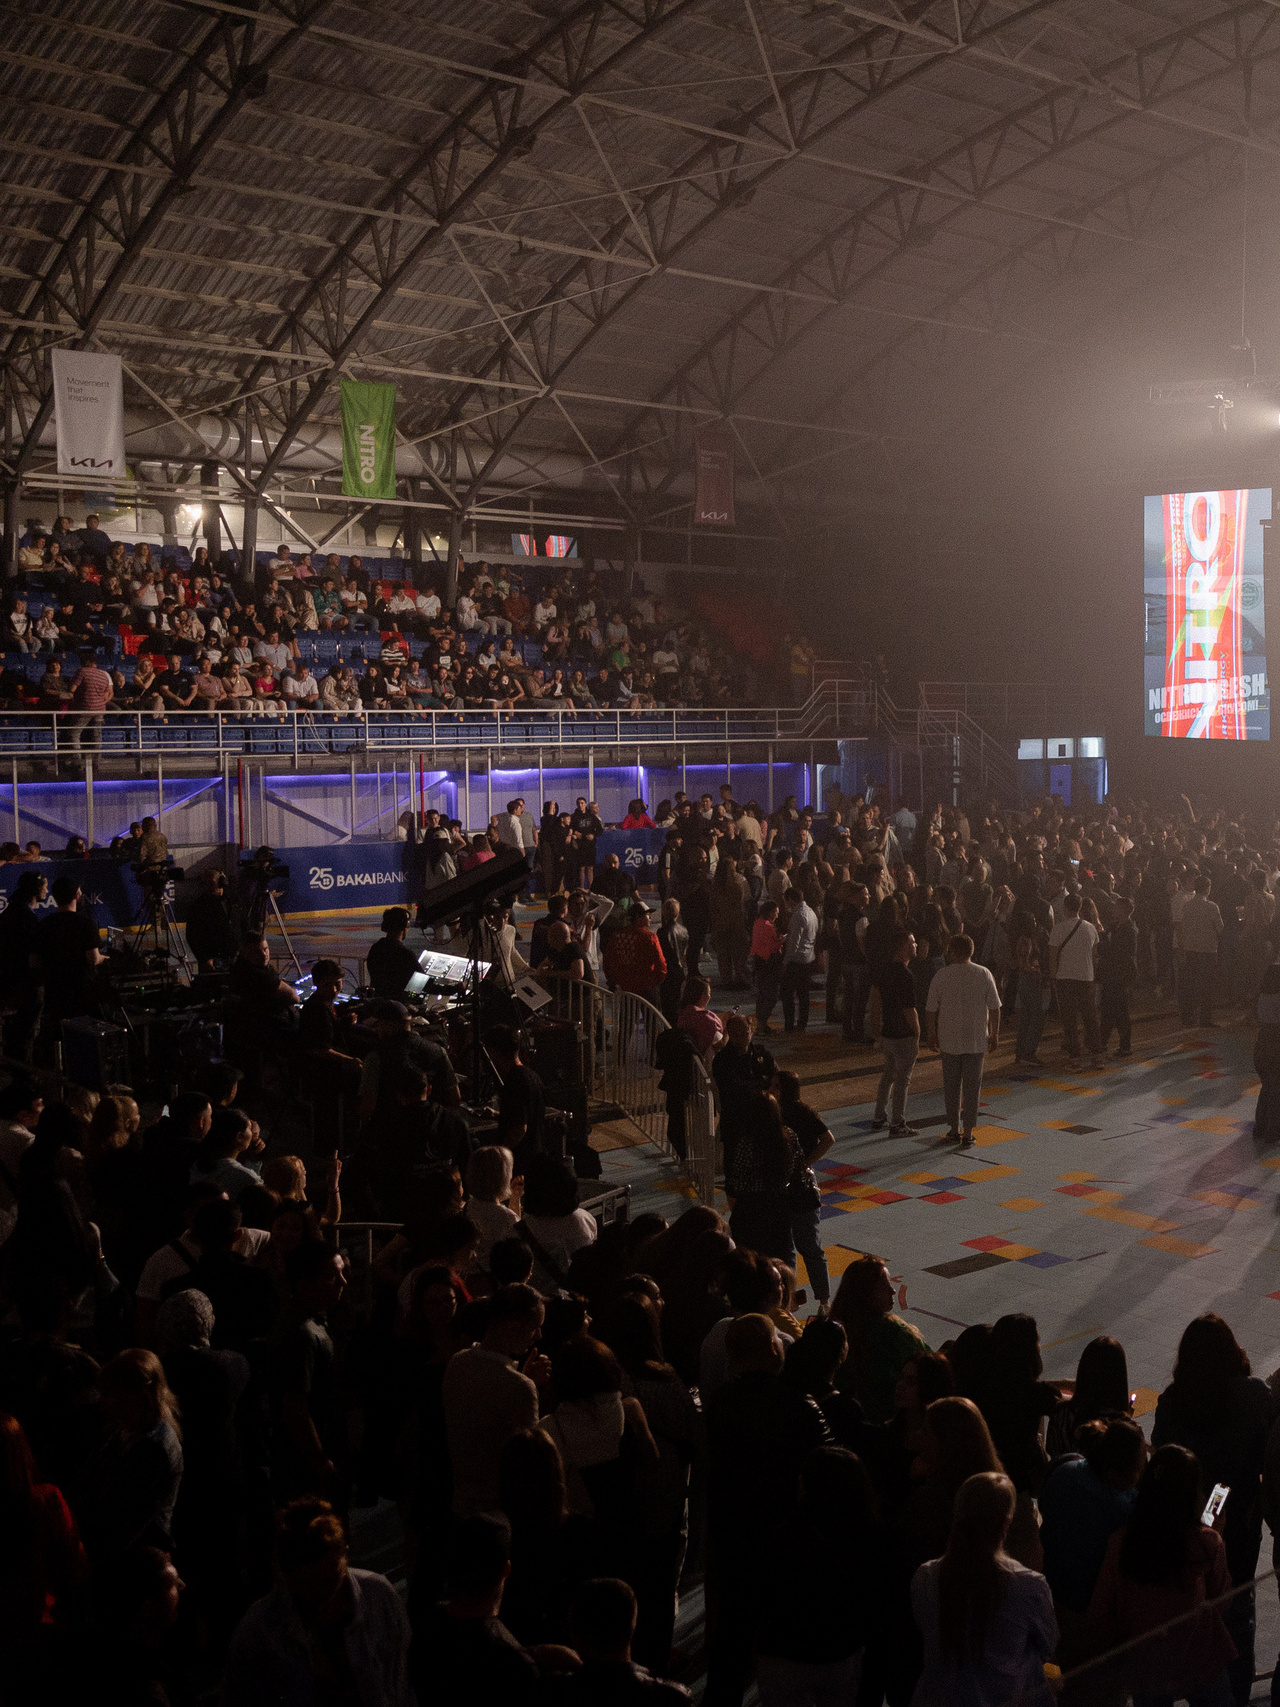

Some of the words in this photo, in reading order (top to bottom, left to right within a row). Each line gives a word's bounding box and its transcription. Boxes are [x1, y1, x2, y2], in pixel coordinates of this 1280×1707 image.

[66, 377, 111, 389] Movement
[67, 386, 83, 394] that
[67, 394, 99, 404] inspires
[359, 424, 376, 484] NITRO
[624, 847, 644, 868] 25
[308, 866, 335, 891] 25
